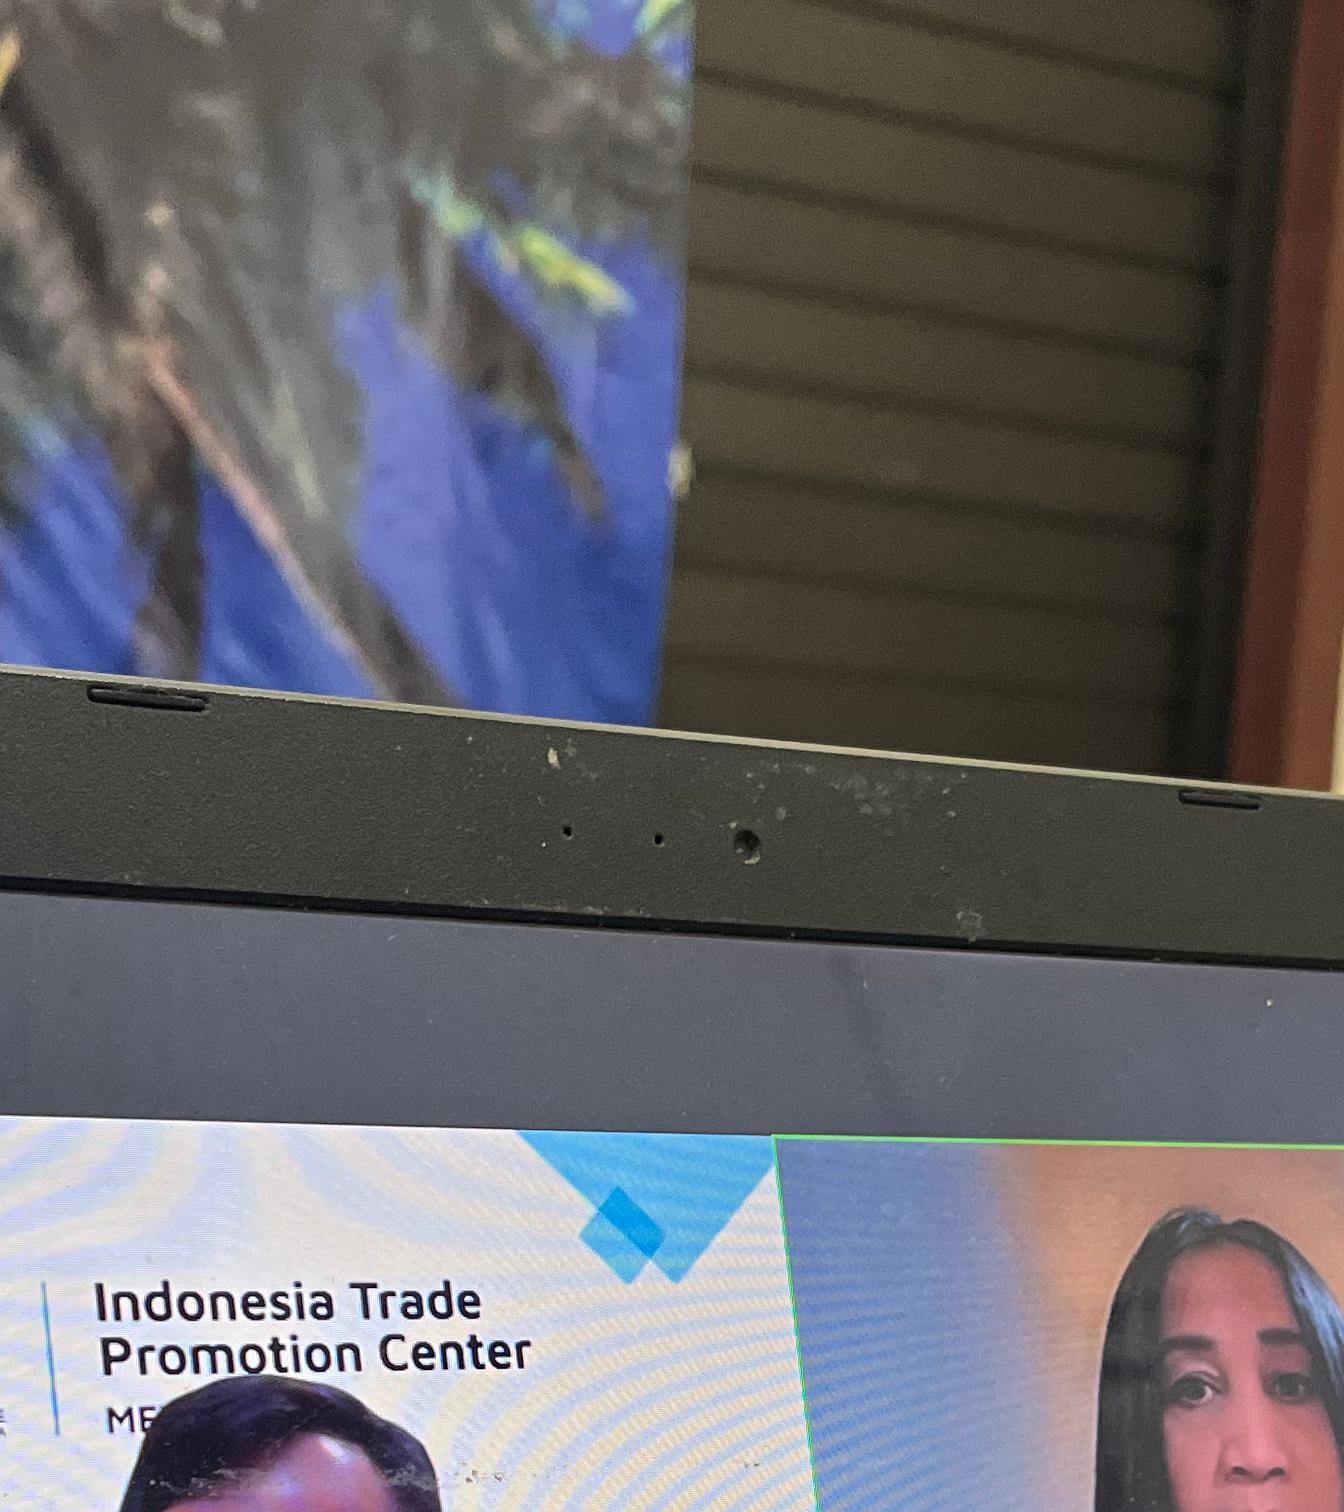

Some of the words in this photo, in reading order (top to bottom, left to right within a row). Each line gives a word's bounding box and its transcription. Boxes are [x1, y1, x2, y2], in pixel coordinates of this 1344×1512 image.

[93, 1279, 335, 1322] Indonesia
[349, 1280, 483, 1321] Trade
[100, 1334, 363, 1376] Promotion
[378, 1332, 532, 1372] Center
